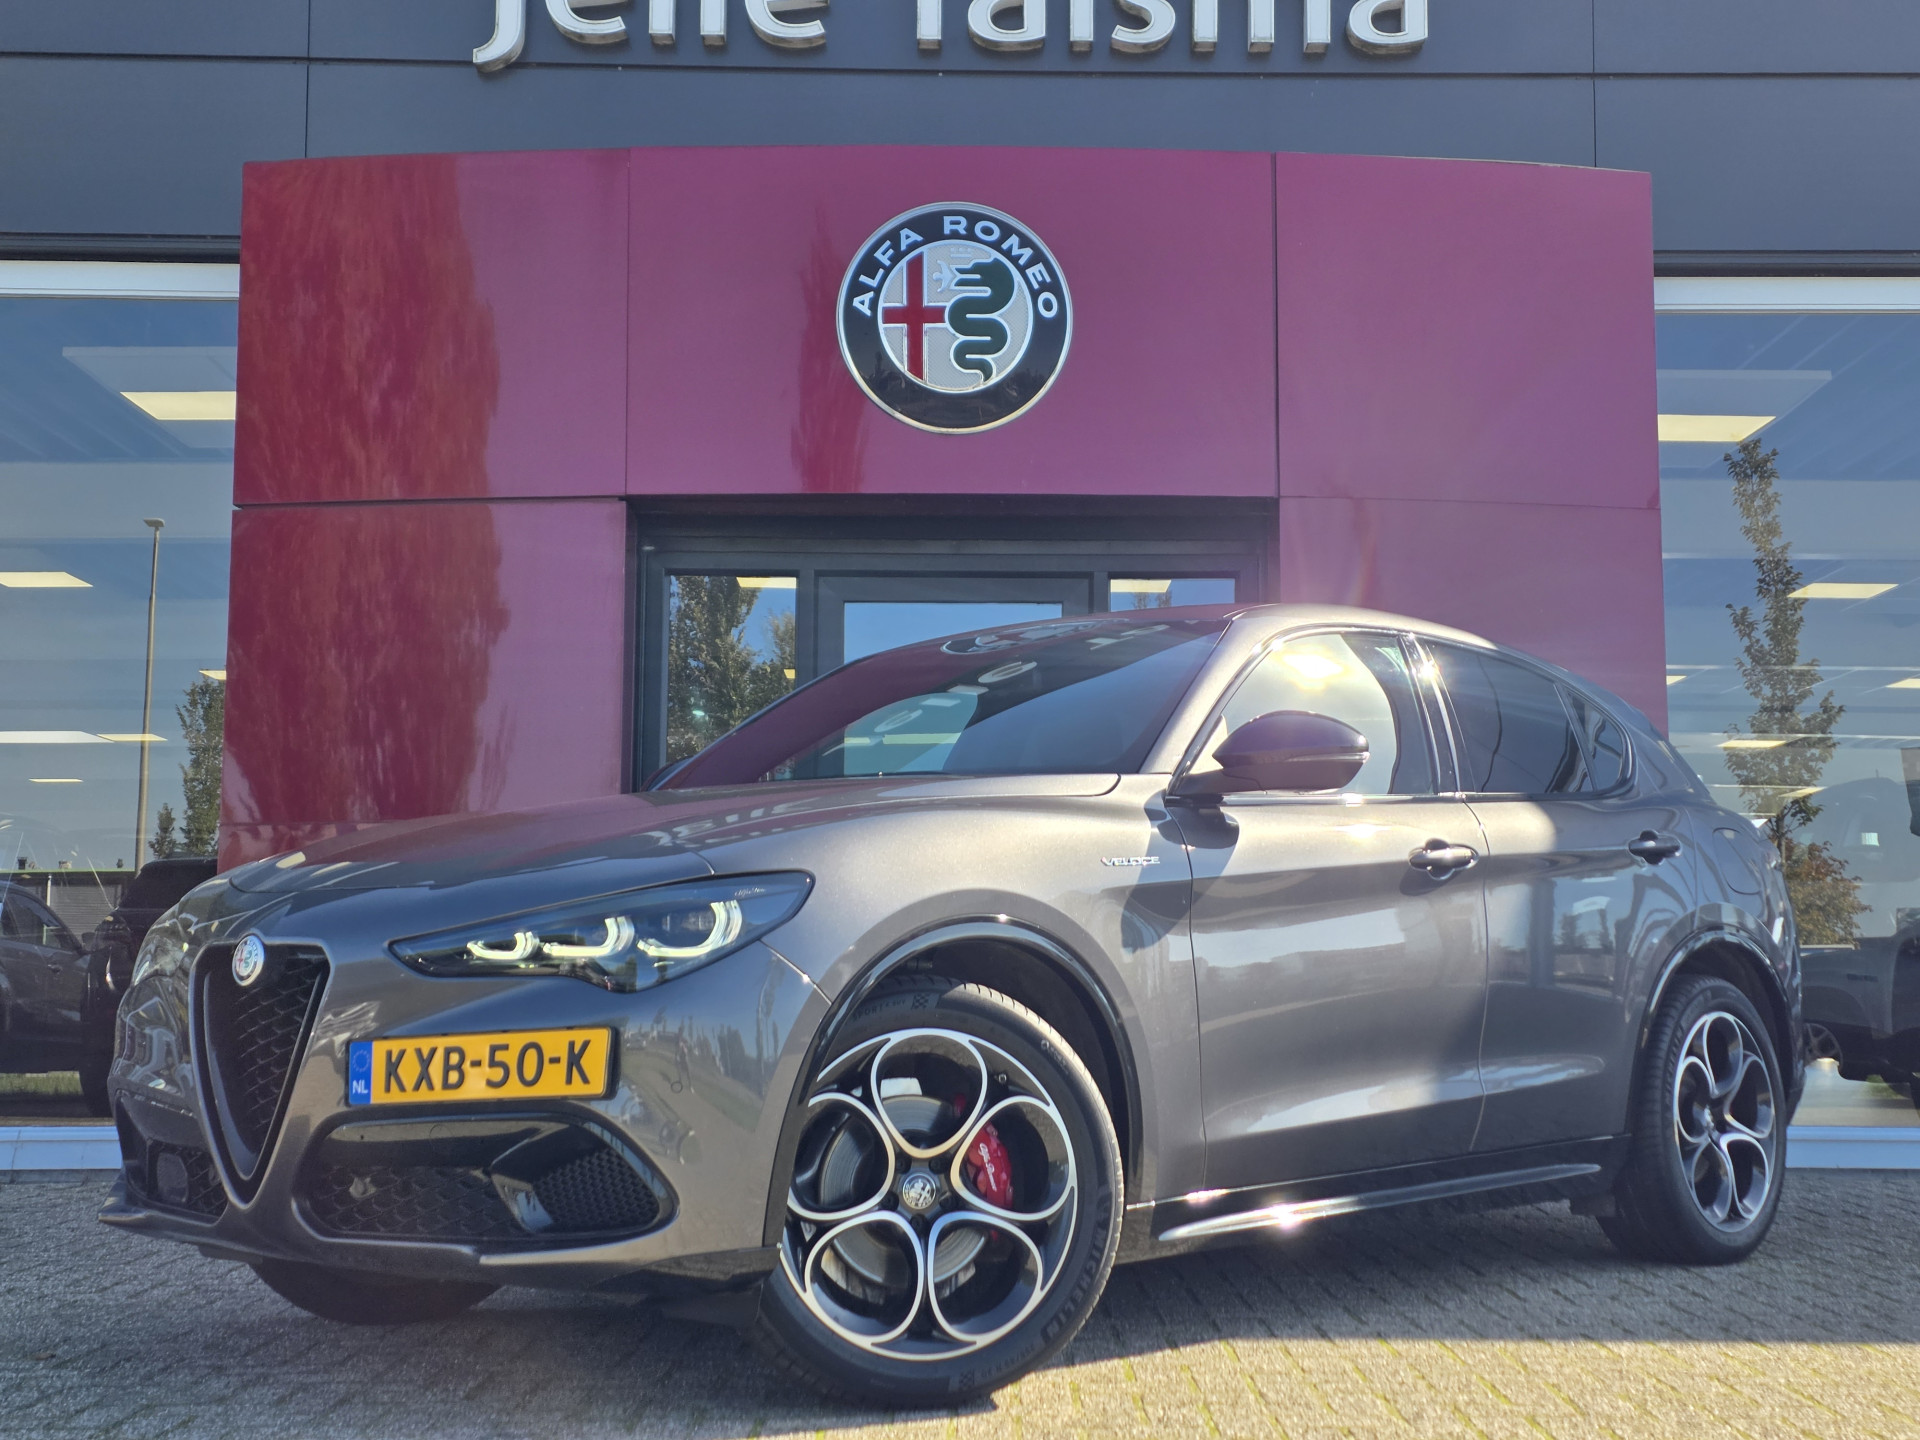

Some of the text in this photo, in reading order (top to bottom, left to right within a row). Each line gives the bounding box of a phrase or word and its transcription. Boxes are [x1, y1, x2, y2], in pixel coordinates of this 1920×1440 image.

[852, 215, 1058, 318] ALFA ROMEO
[1100, 856, 1161, 867] VELOCE
[383, 1039, 592, 1094] KXB-50-K
[352, 1079, 369, 1094] NL
